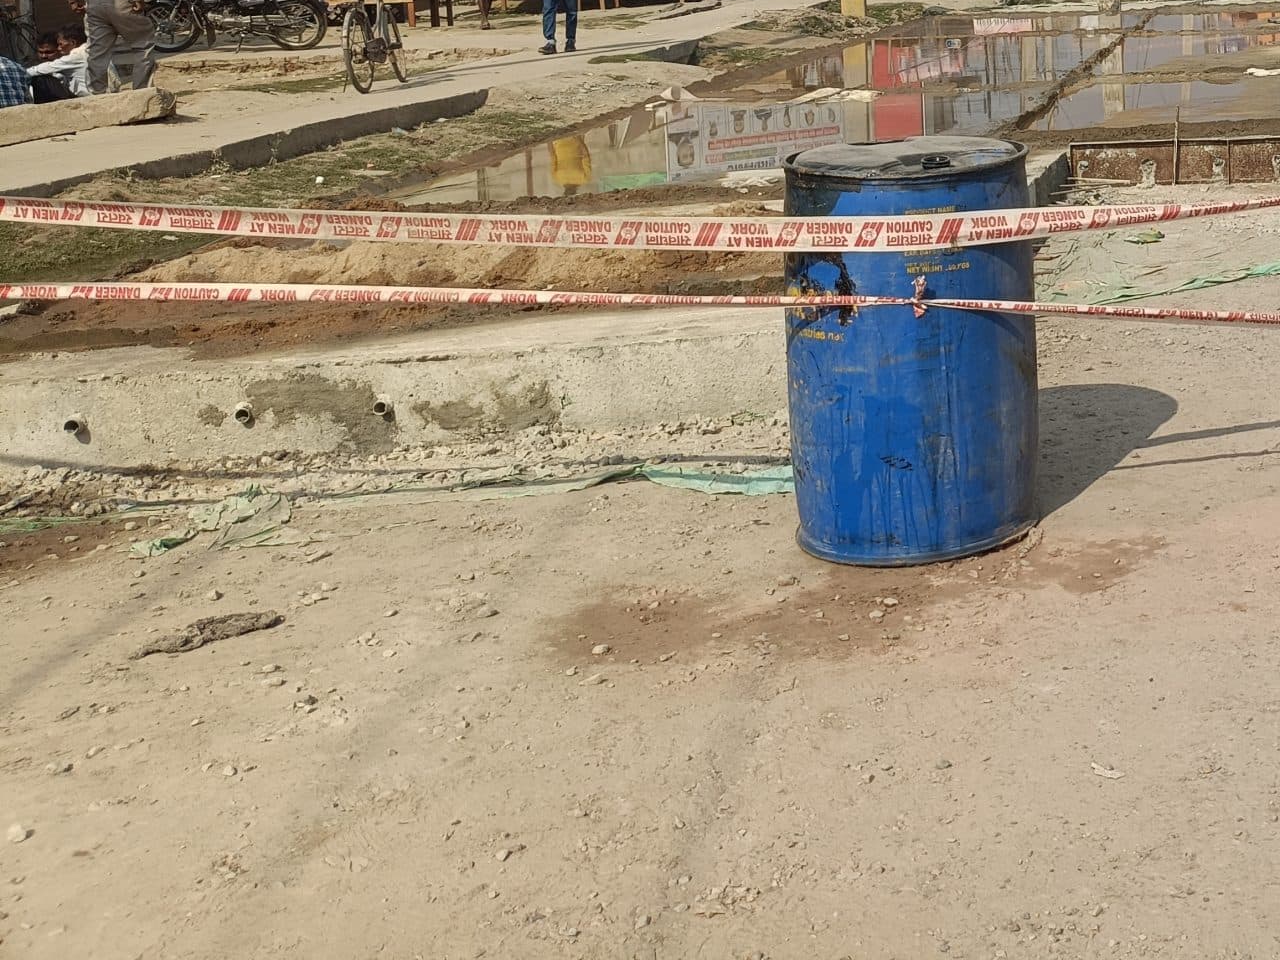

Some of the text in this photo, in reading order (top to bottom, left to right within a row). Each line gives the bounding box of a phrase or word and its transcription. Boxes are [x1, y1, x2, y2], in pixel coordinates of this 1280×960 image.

[13, 207, 60, 221] MEN AT
[90, 203, 135, 214] DANGER
[165, 207, 213, 218] CAUTION
[97, 211, 133, 225] खतरा
[170, 216, 215, 229] सावधान
[251, 212, 289, 223] WORK
[326, 214, 373, 226] DANGER
[403, 216, 451, 228] CAUTION
[971, 216, 1008, 229] WORK
[1043, 209, 1086, 223] DANGER
[1116, 213, 1158, 225] सावधान
[250, 222, 296, 235] MEN AT
[334, 224, 370, 237] खतरा
[488, 219, 528, 231] WORK
[564, 220, 611, 233] DANGER
[644, 222, 691, 234] CAUTION
[730, 223, 769, 235] WORK
[806, 222, 853, 234] DANGER
[886, 220, 933, 234] CAUTION
[1049, 220, 1083, 233] खतरा
[407, 227, 453, 240] सावधान
[488, 232, 535, 244] MEN AT
[572, 231, 608, 244] खतरा
[646, 232, 692, 246] सावधान
[887, 232, 933, 247] सावधान
[968, 227, 1013, 241] MEN AT
[726, 236, 774, 247] MEN AT
[812, 234, 849, 247] खतरा
[20, 286, 58, 298] WORK
[95, 286, 141, 299] DANGER
[174, 287, 220, 300] CAUTION
[260, 289, 297, 301] WORK
[335, 290, 381, 302] DANGER
[414, 290, 460, 303] CAUTION
[501, 292, 538, 304] WORK
[575, 295, 622, 304] DANGER
